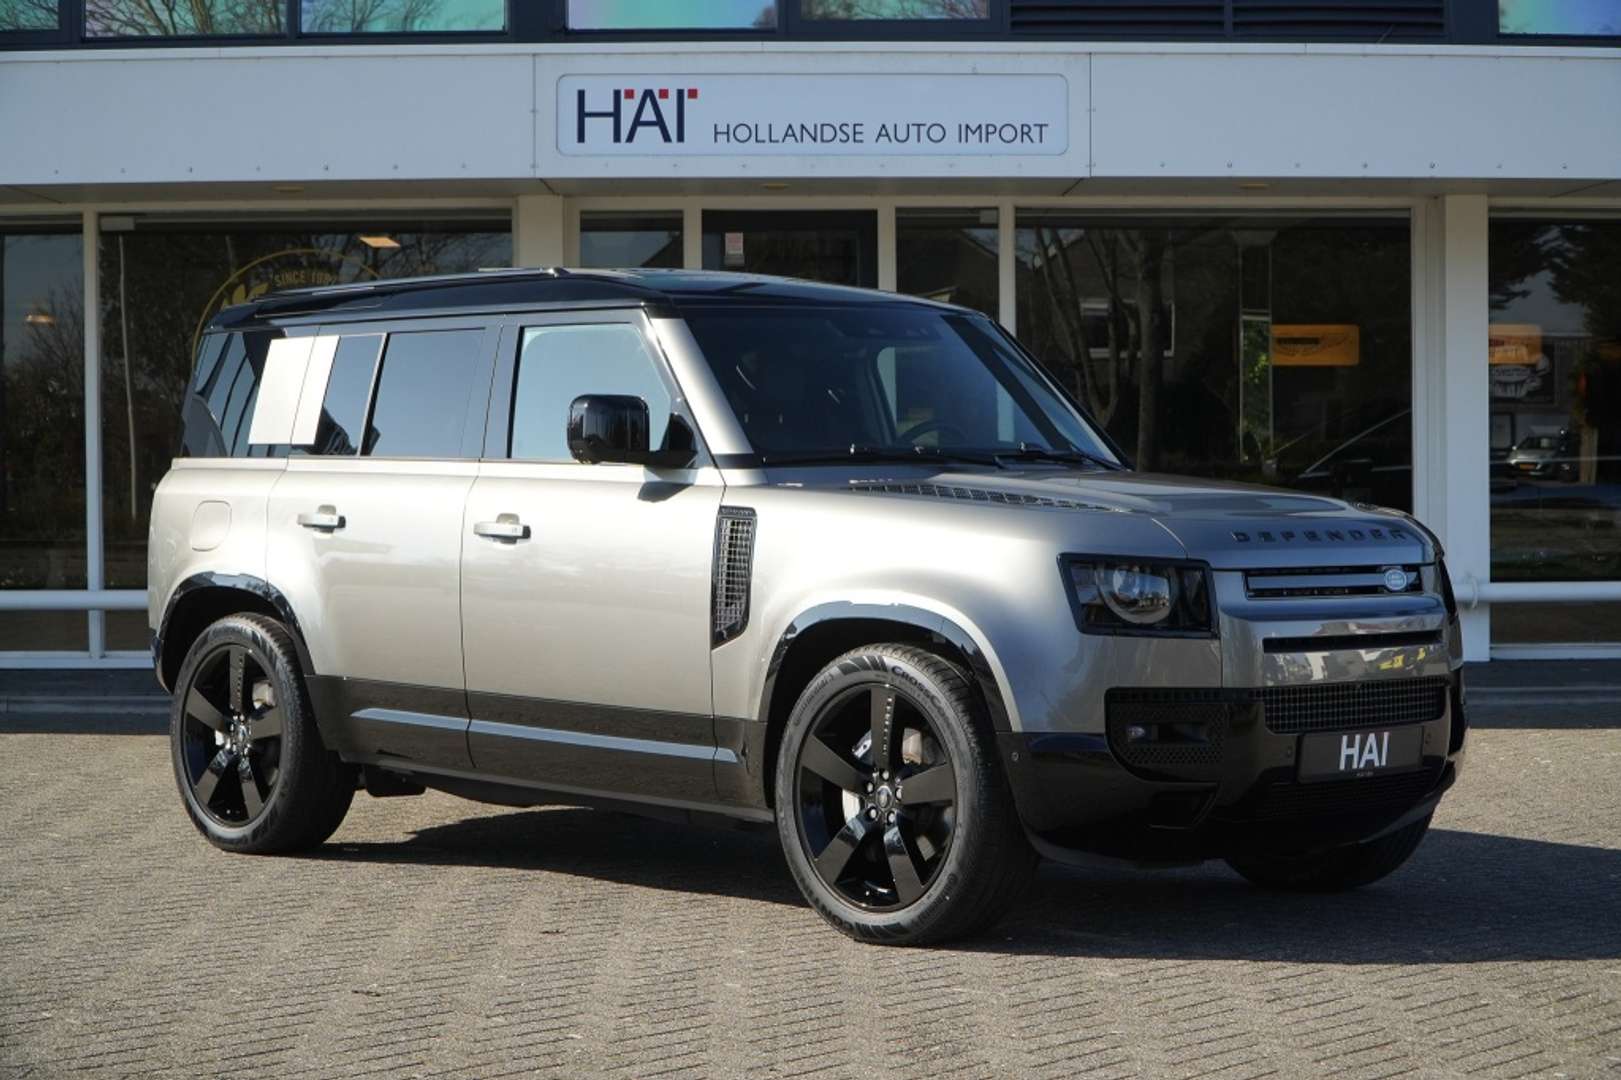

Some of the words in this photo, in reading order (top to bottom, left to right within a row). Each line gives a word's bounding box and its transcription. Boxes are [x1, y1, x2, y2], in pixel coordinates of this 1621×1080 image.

[577, 88, 697, 144] HAI
[713, 123, 864, 144] HOLLANDSE
[875, 123, 947, 144] AUTO
[958, 123, 1049, 144] IMPORT
[1232, 528, 1409, 543] DEFENDER
[1339, 731, 1390, 771] HAI
